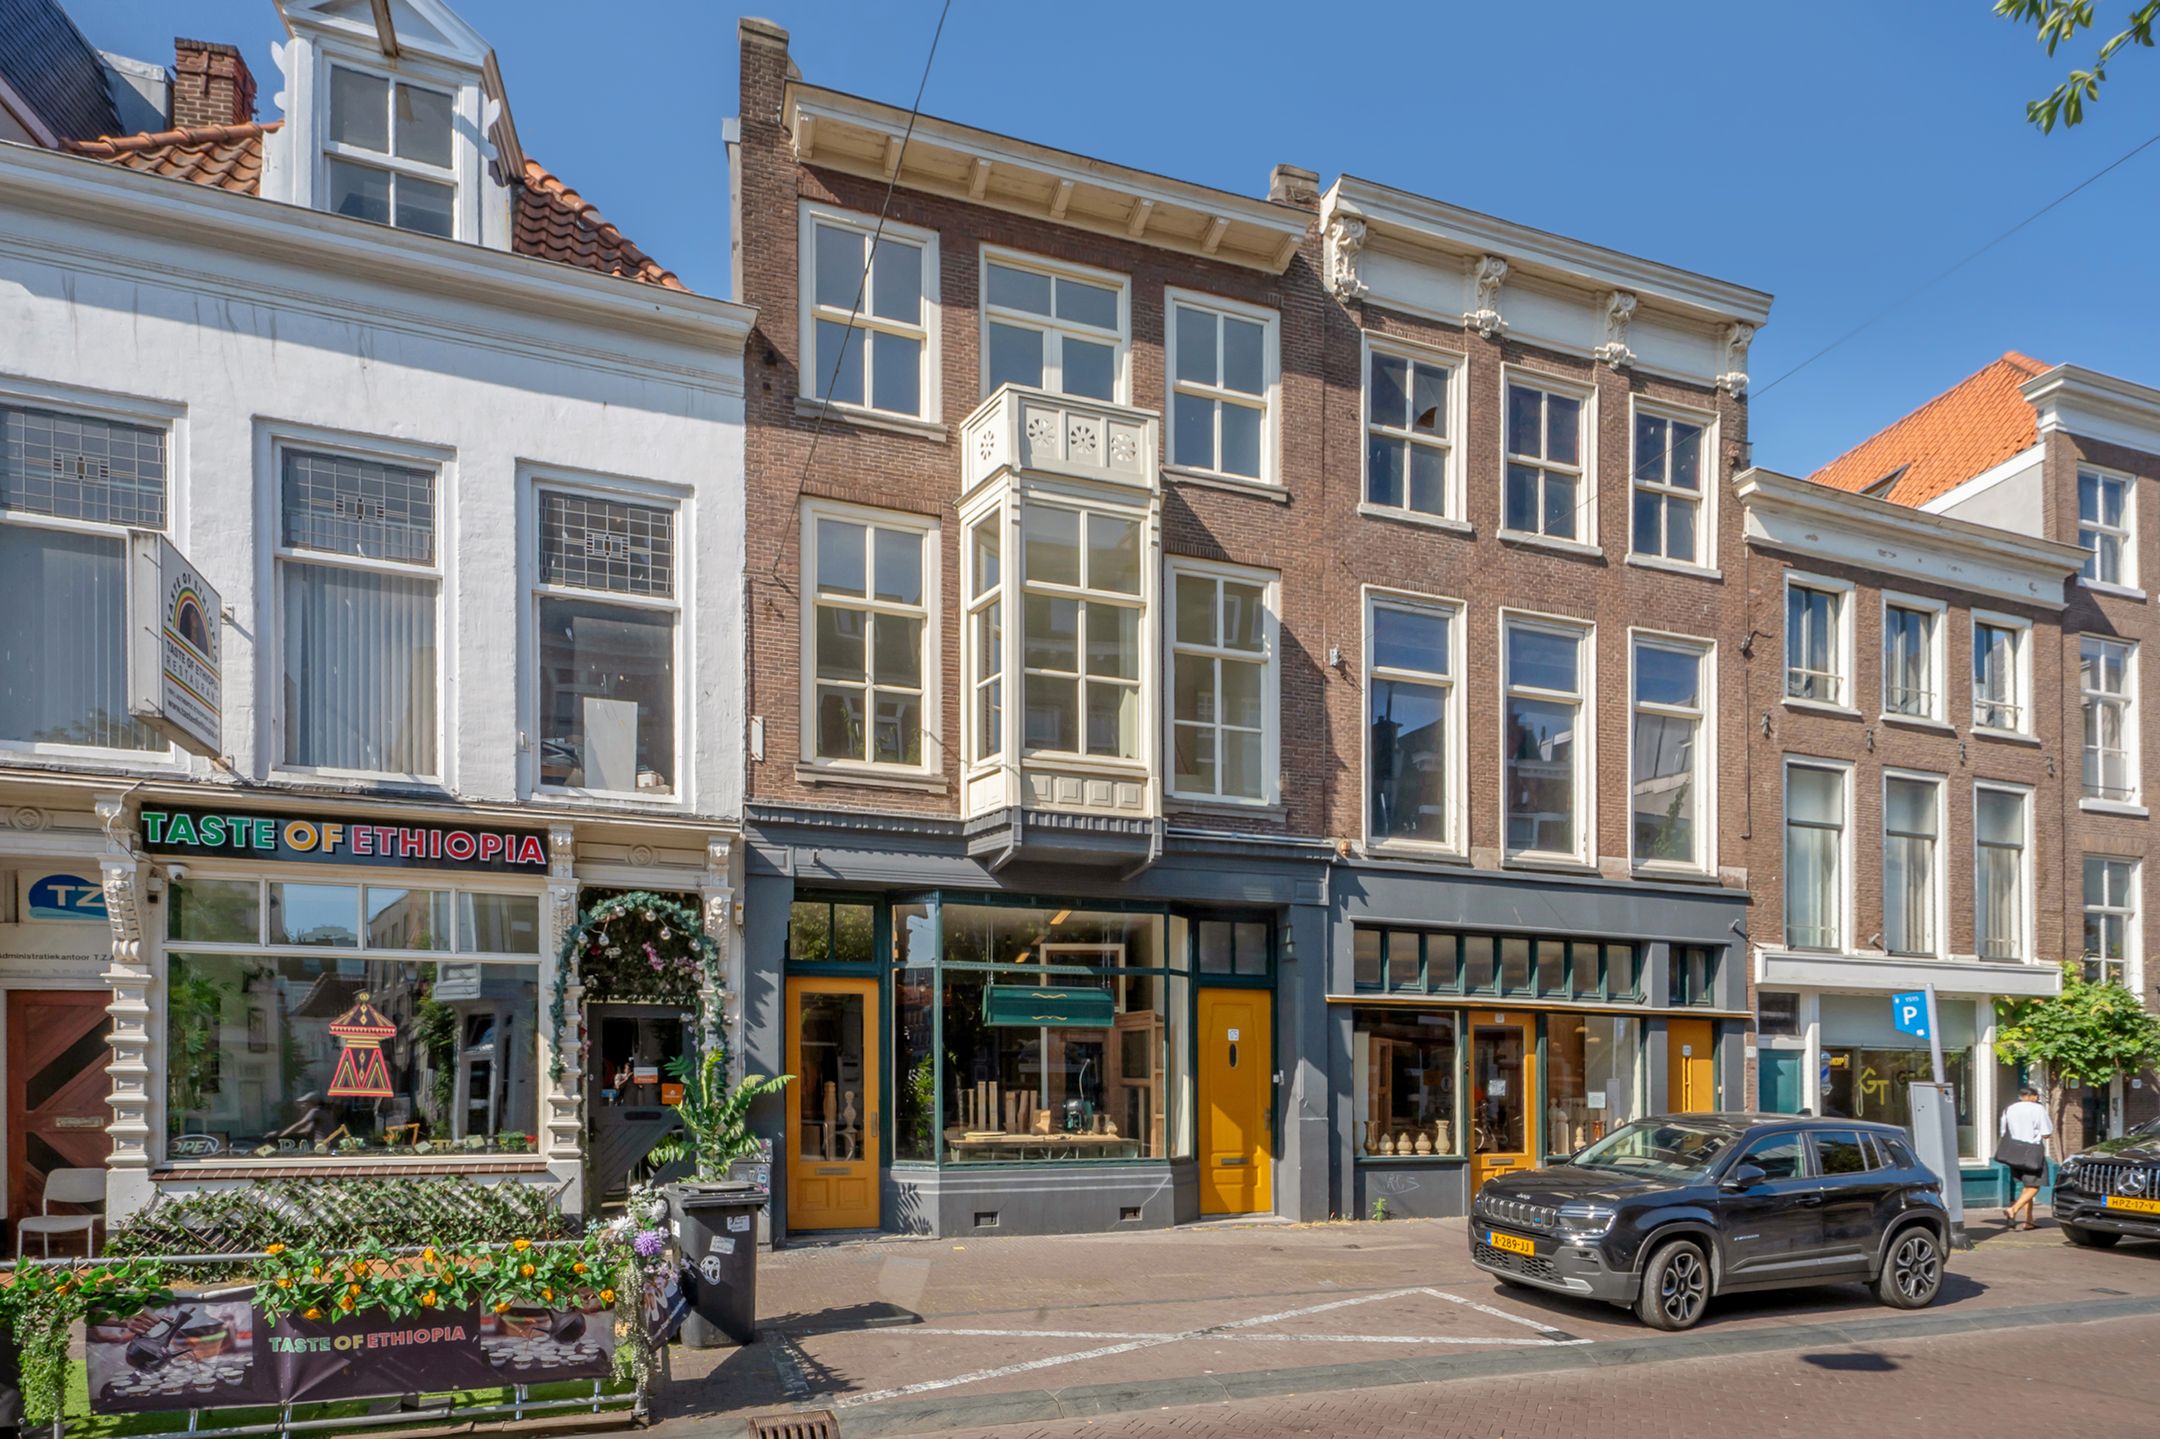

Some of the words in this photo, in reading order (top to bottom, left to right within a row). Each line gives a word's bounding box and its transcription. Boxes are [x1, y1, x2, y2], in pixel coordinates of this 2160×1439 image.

[166, 640, 186, 665] TASTE
[166, 654, 219, 705] RESTAURANT
[141, 811, 277, 850] TASTE
[283, 820, 343, 853] OF
[352, 825, 547, 865] ETHIOPIA
[1903, 1006, 1918, 1025] P
[2111, 1198, 2156, 1210] HPZ-17-V
[1494, 1234, 1530, 1252] X-289-JJ
[269, 1336, 331, 1353] TASTE
[333, 1335, 364, 1351] OF
[366, 1325, 466, 1349] ETHIOPIA
